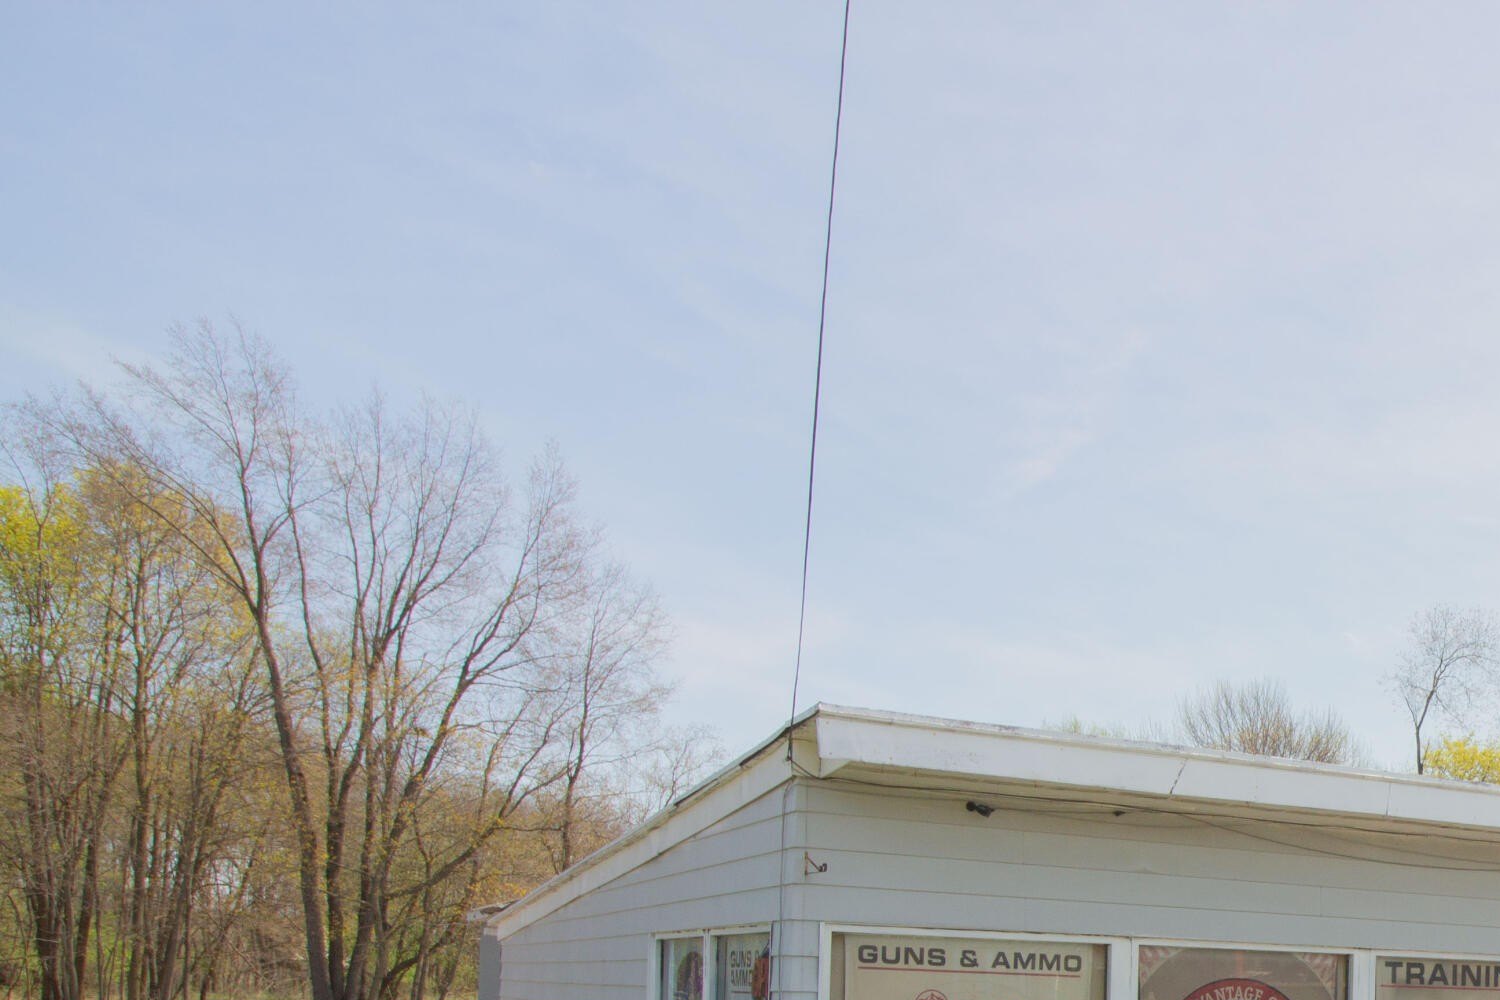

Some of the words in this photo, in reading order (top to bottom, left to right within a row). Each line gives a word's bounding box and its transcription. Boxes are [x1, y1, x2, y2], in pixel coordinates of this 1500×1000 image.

[858, 944, 946, 967] GUNS
[960, 950, 979, 968] &
[992, 951, 1082, 972] AMMO
